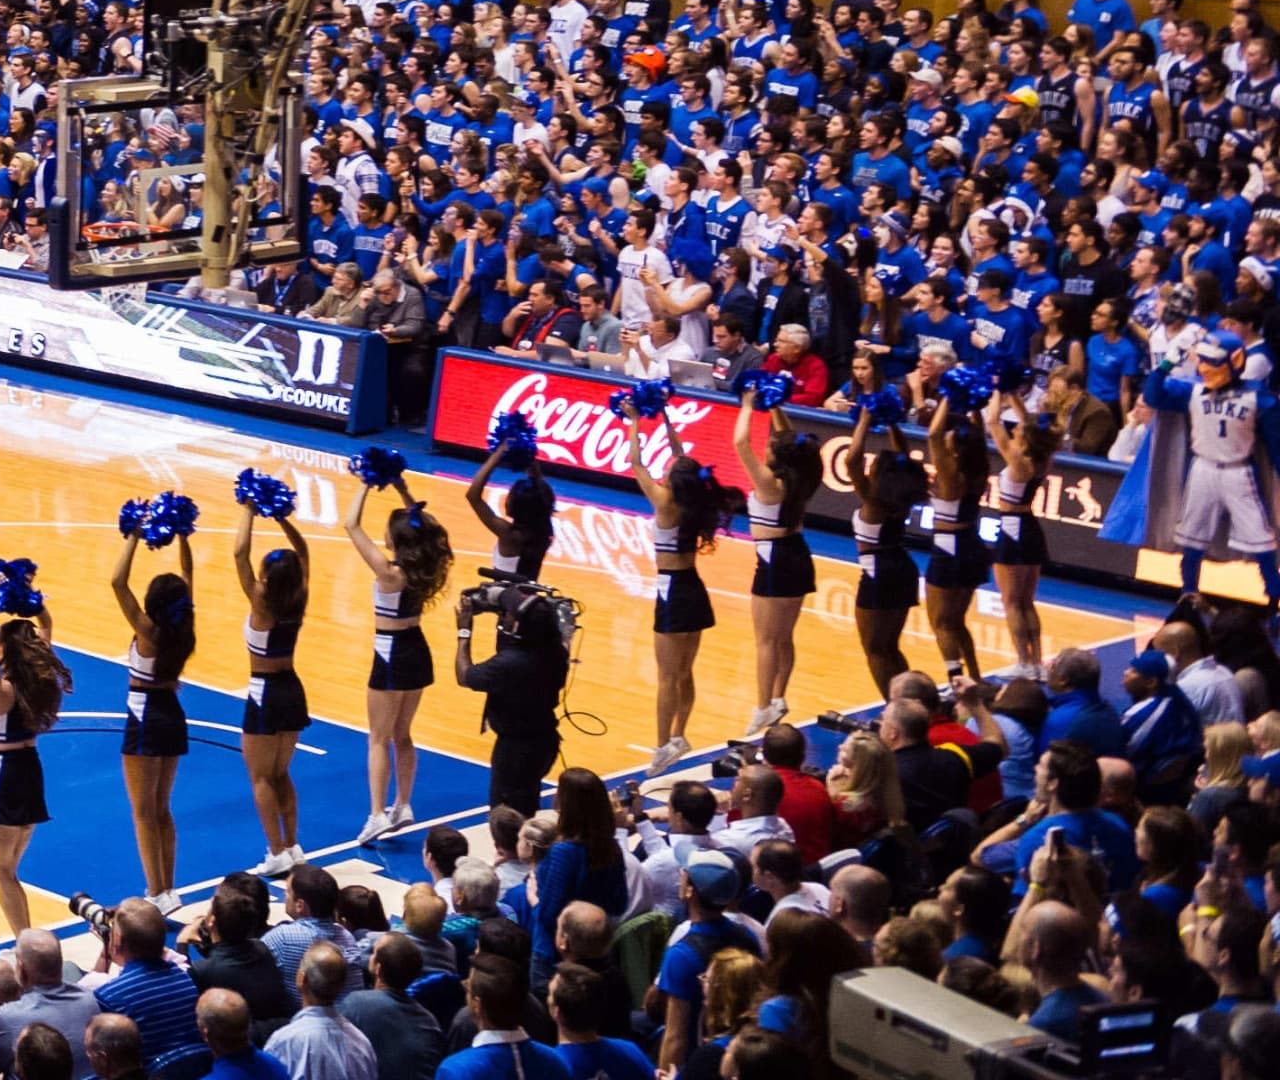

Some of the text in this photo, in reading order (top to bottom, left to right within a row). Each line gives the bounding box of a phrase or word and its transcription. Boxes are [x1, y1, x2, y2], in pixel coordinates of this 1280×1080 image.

[292, 330, 344, 386] D
[1202, 399, 1249, 420] DUKE
[1218, 419, 1228, 437] 1
